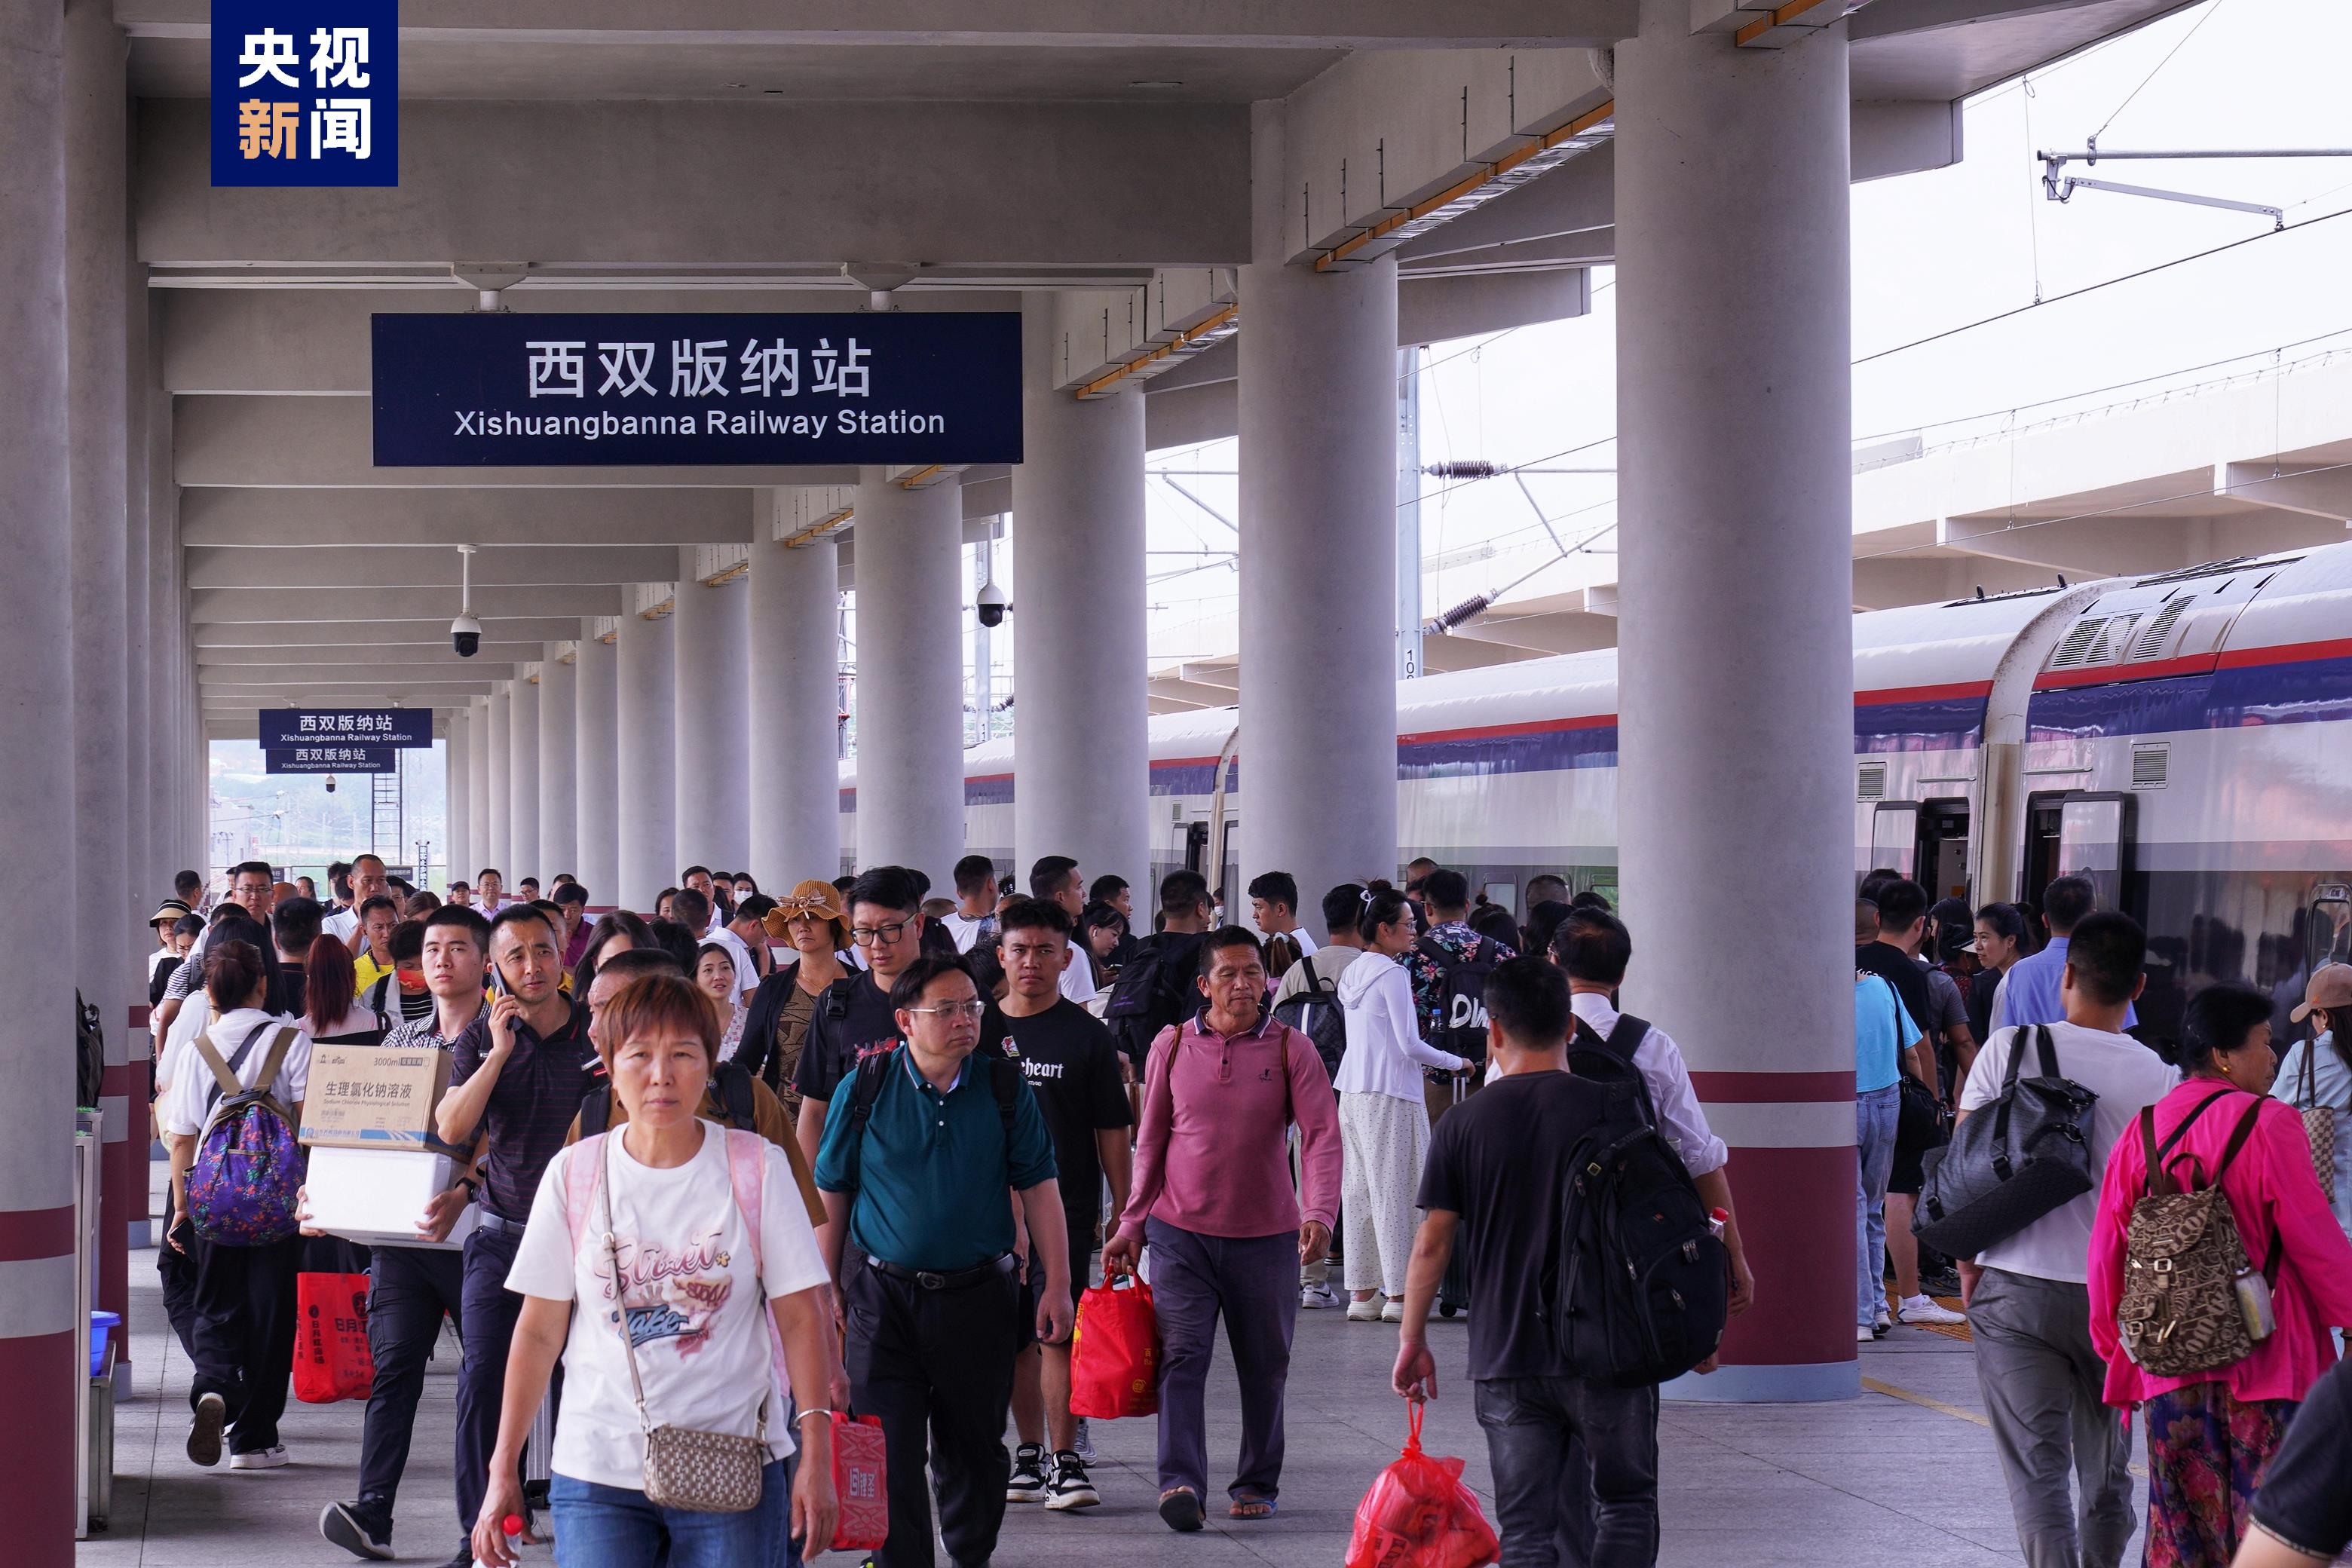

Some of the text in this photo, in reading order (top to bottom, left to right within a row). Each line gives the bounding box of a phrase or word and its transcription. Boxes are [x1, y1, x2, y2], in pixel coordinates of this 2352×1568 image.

[525, 338, 871, 398] 西双版纳站
[454, 409, 944, 440] Xishuangbanna Railway Station
[299, 715, 393, 732] 西双版纳站
[280, 733, 346, 743] Xishuangbanna
[347, 733, 381, 743] Railway
[296, 749, 366, 761] 西双版纳站
[373, 1057, 401, 1067] 3000ml
[325, 1081, 412, 1098] 生理氯化钠溶液
